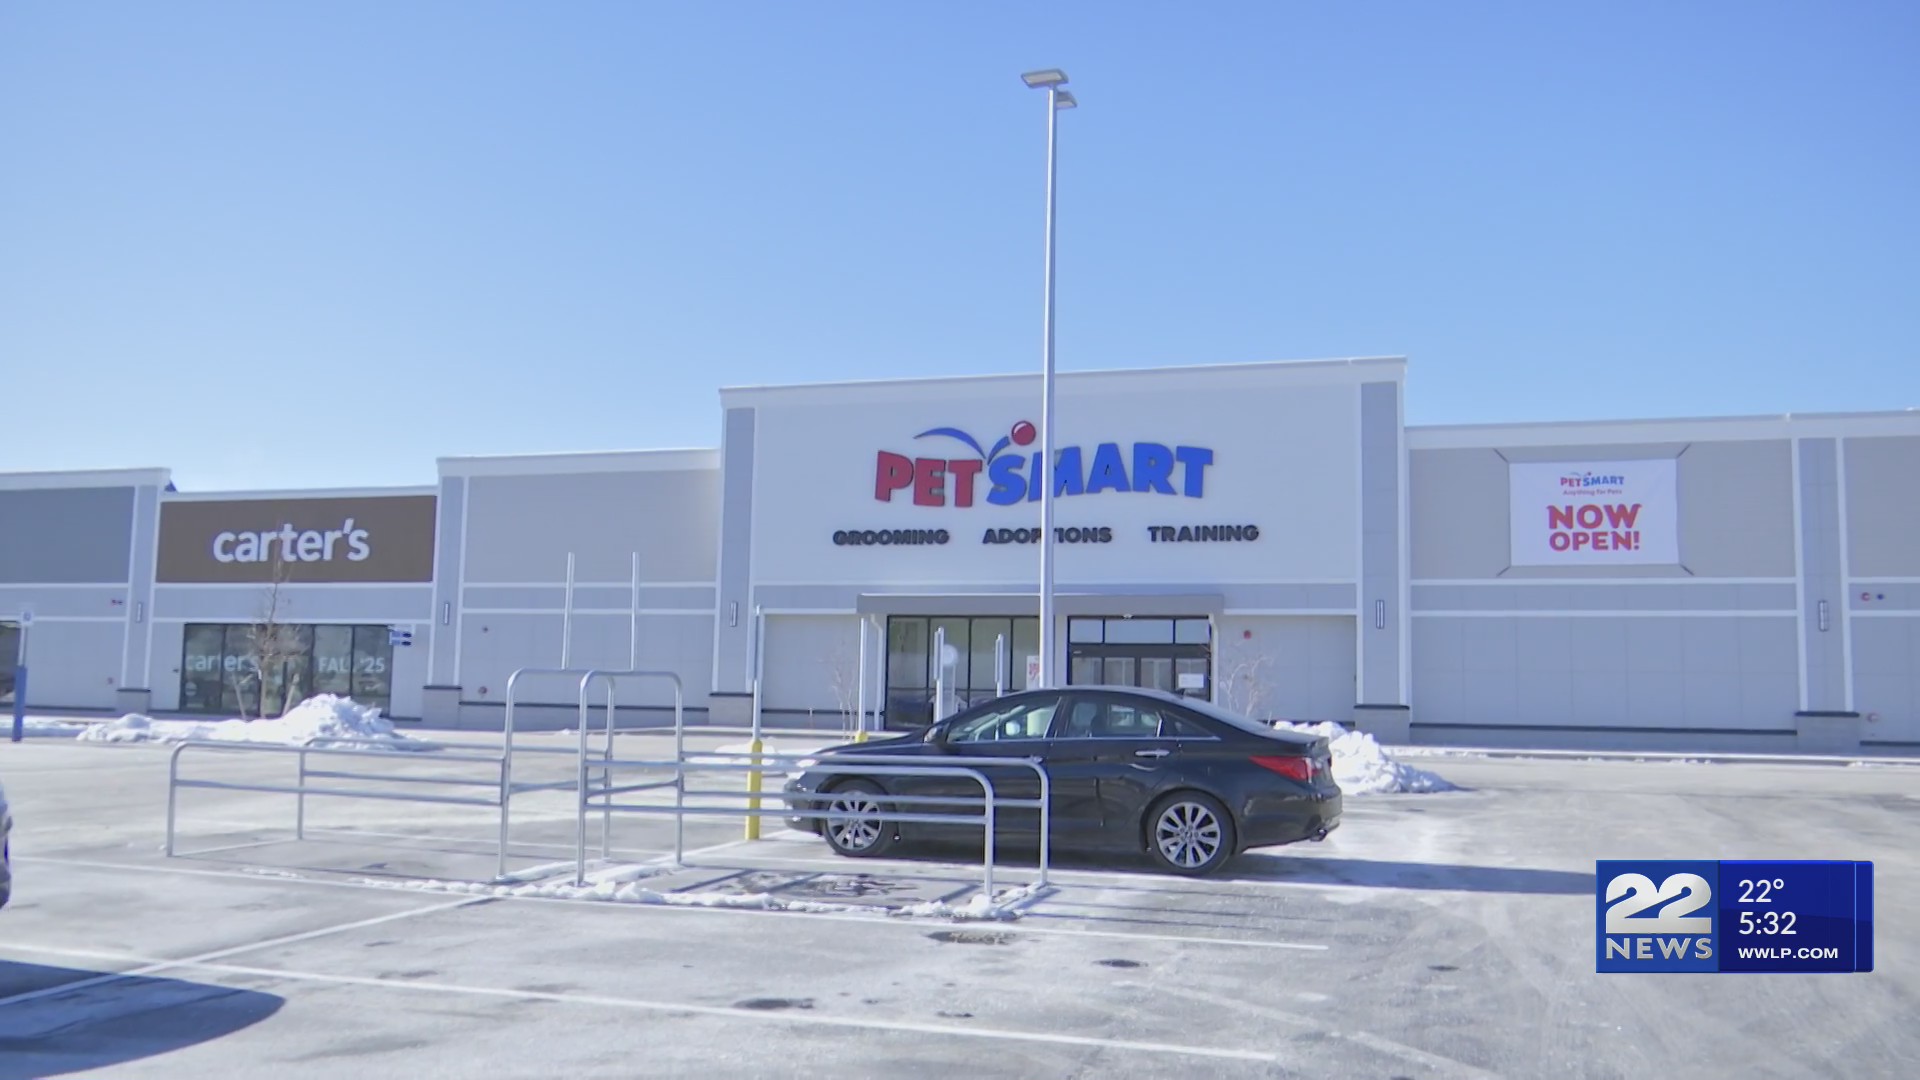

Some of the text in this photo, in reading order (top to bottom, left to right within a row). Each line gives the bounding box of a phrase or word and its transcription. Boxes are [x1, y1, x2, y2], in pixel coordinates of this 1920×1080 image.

[875, 442, 1213, 507] PETSMART
[1560, 475, 1624, 487] PETSMART
[1547, 503, 1642, 529] NOW
[213, 517, 370, 562] carter's
[832, 529, 950, 546] GROOMING
[1147, 525, 1260, 542] TRAINING
[1549, 531, 1640, 551] OPEN!
